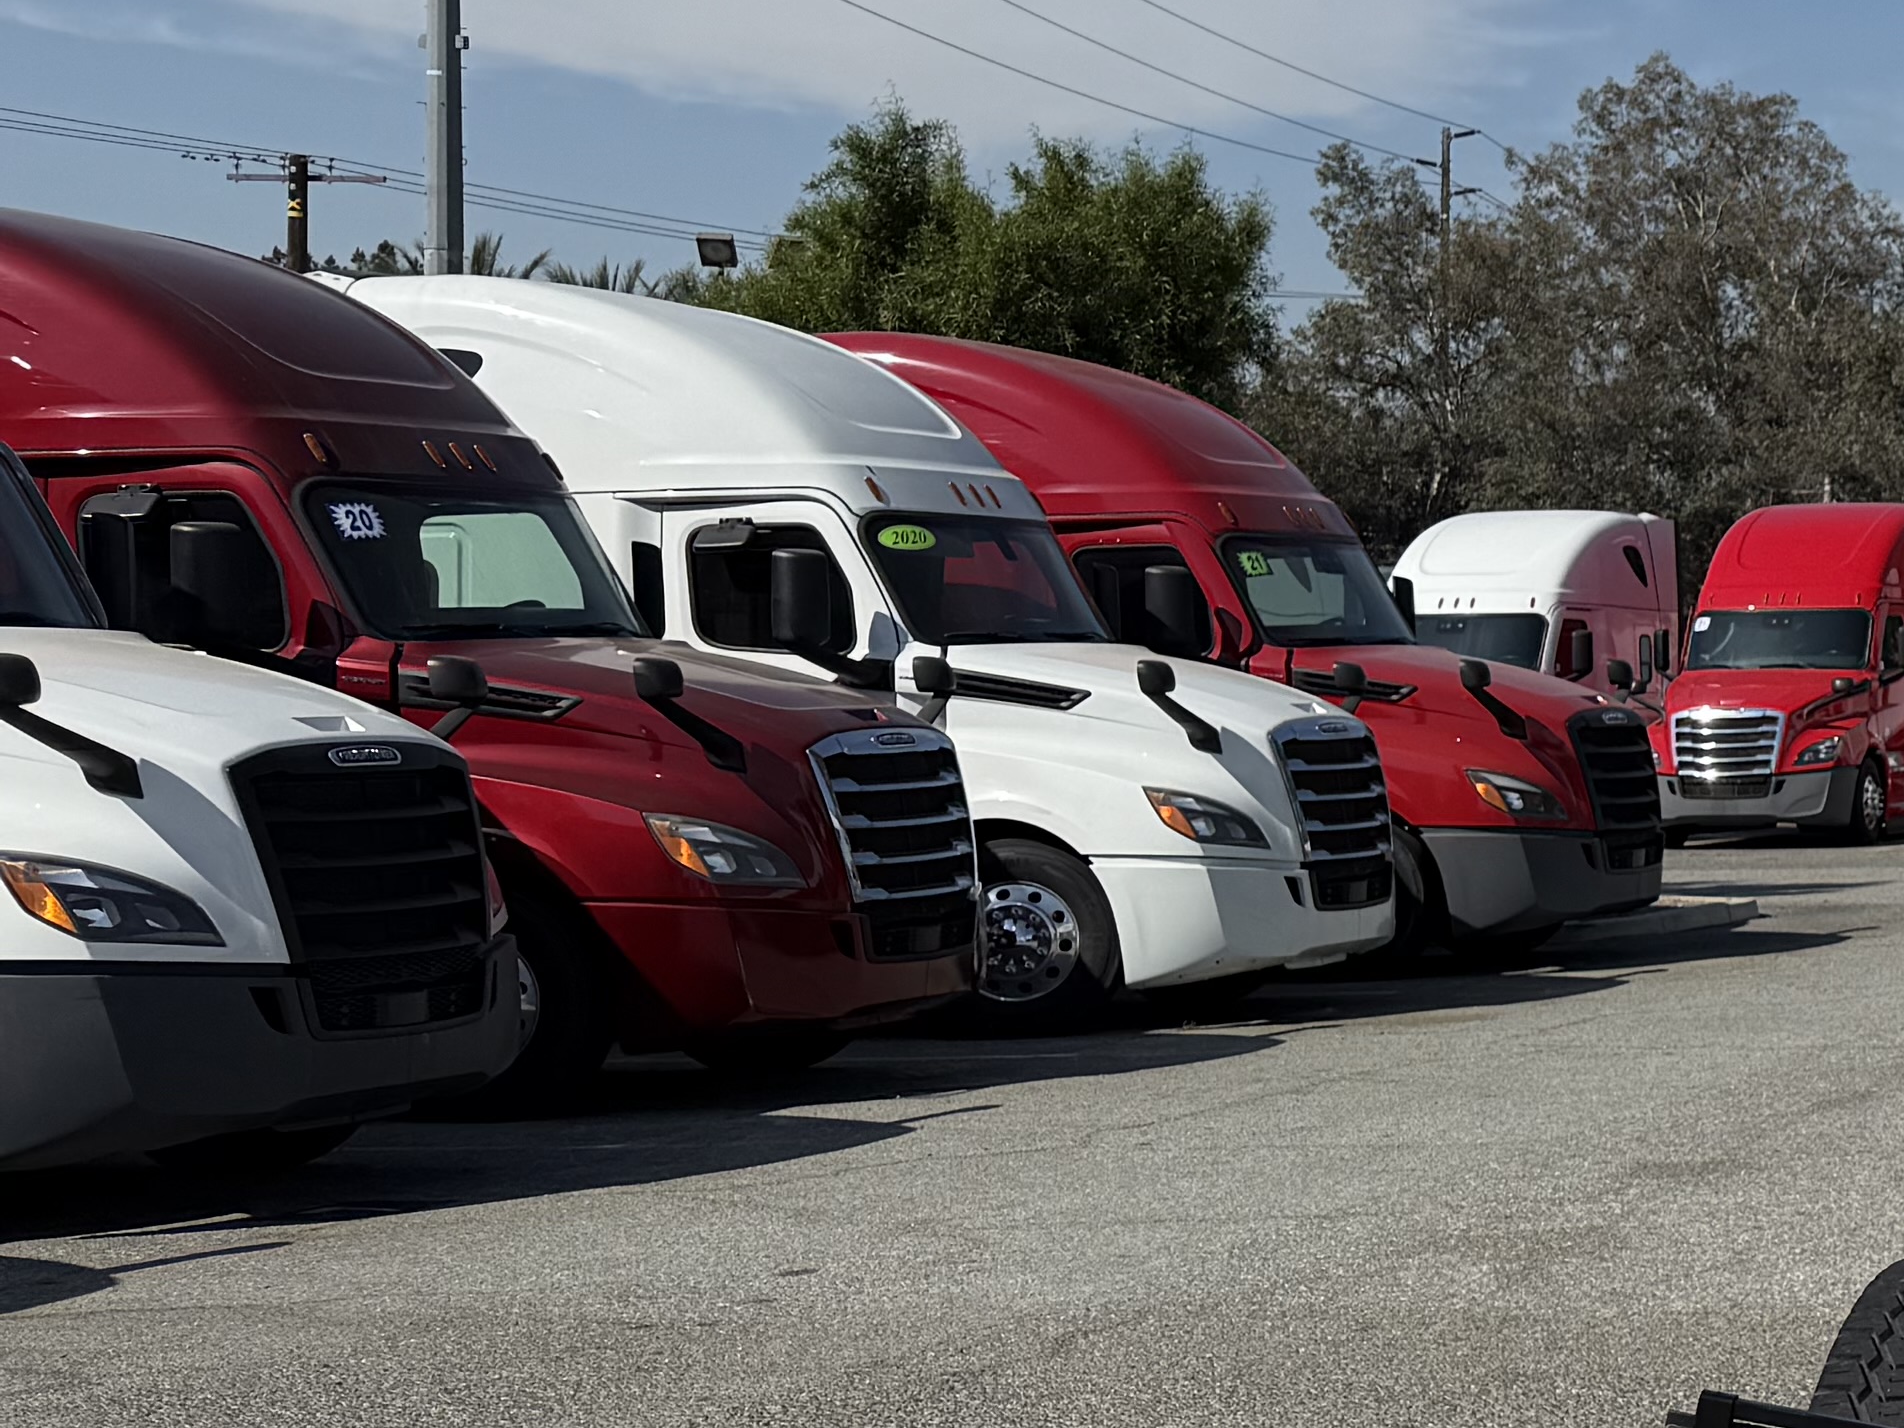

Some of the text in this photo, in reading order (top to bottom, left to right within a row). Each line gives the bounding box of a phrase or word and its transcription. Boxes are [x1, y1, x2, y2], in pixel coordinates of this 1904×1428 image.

[345, 509, 374, 532] 20
[892, 530, 927, 545] 2020
[1247, 555, 1264, 571] 21
